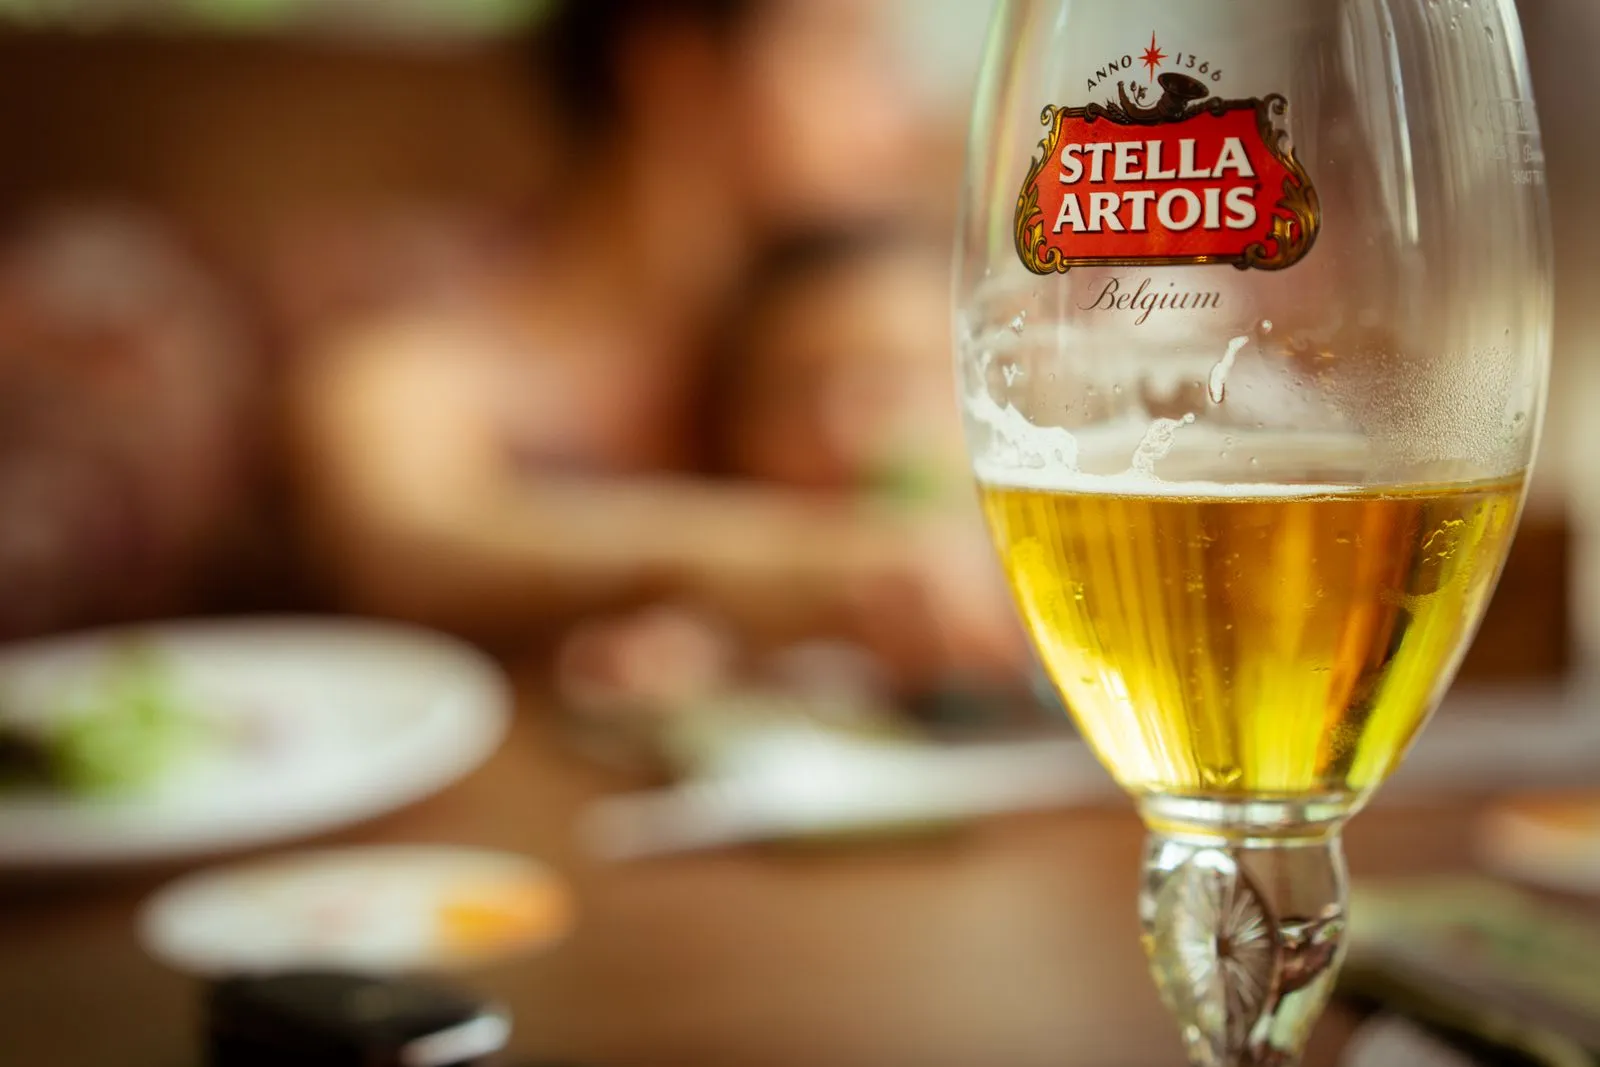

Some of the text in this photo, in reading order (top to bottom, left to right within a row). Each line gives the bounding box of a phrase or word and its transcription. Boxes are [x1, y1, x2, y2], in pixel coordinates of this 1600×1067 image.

[1086, 52, 1222, 92] ANNO 1366
[1058, 137, 1255, 184] STELLA
[1052, 187, 1257, 233] ARTOIS
[1076, 277, 1222, 325] Belgium
